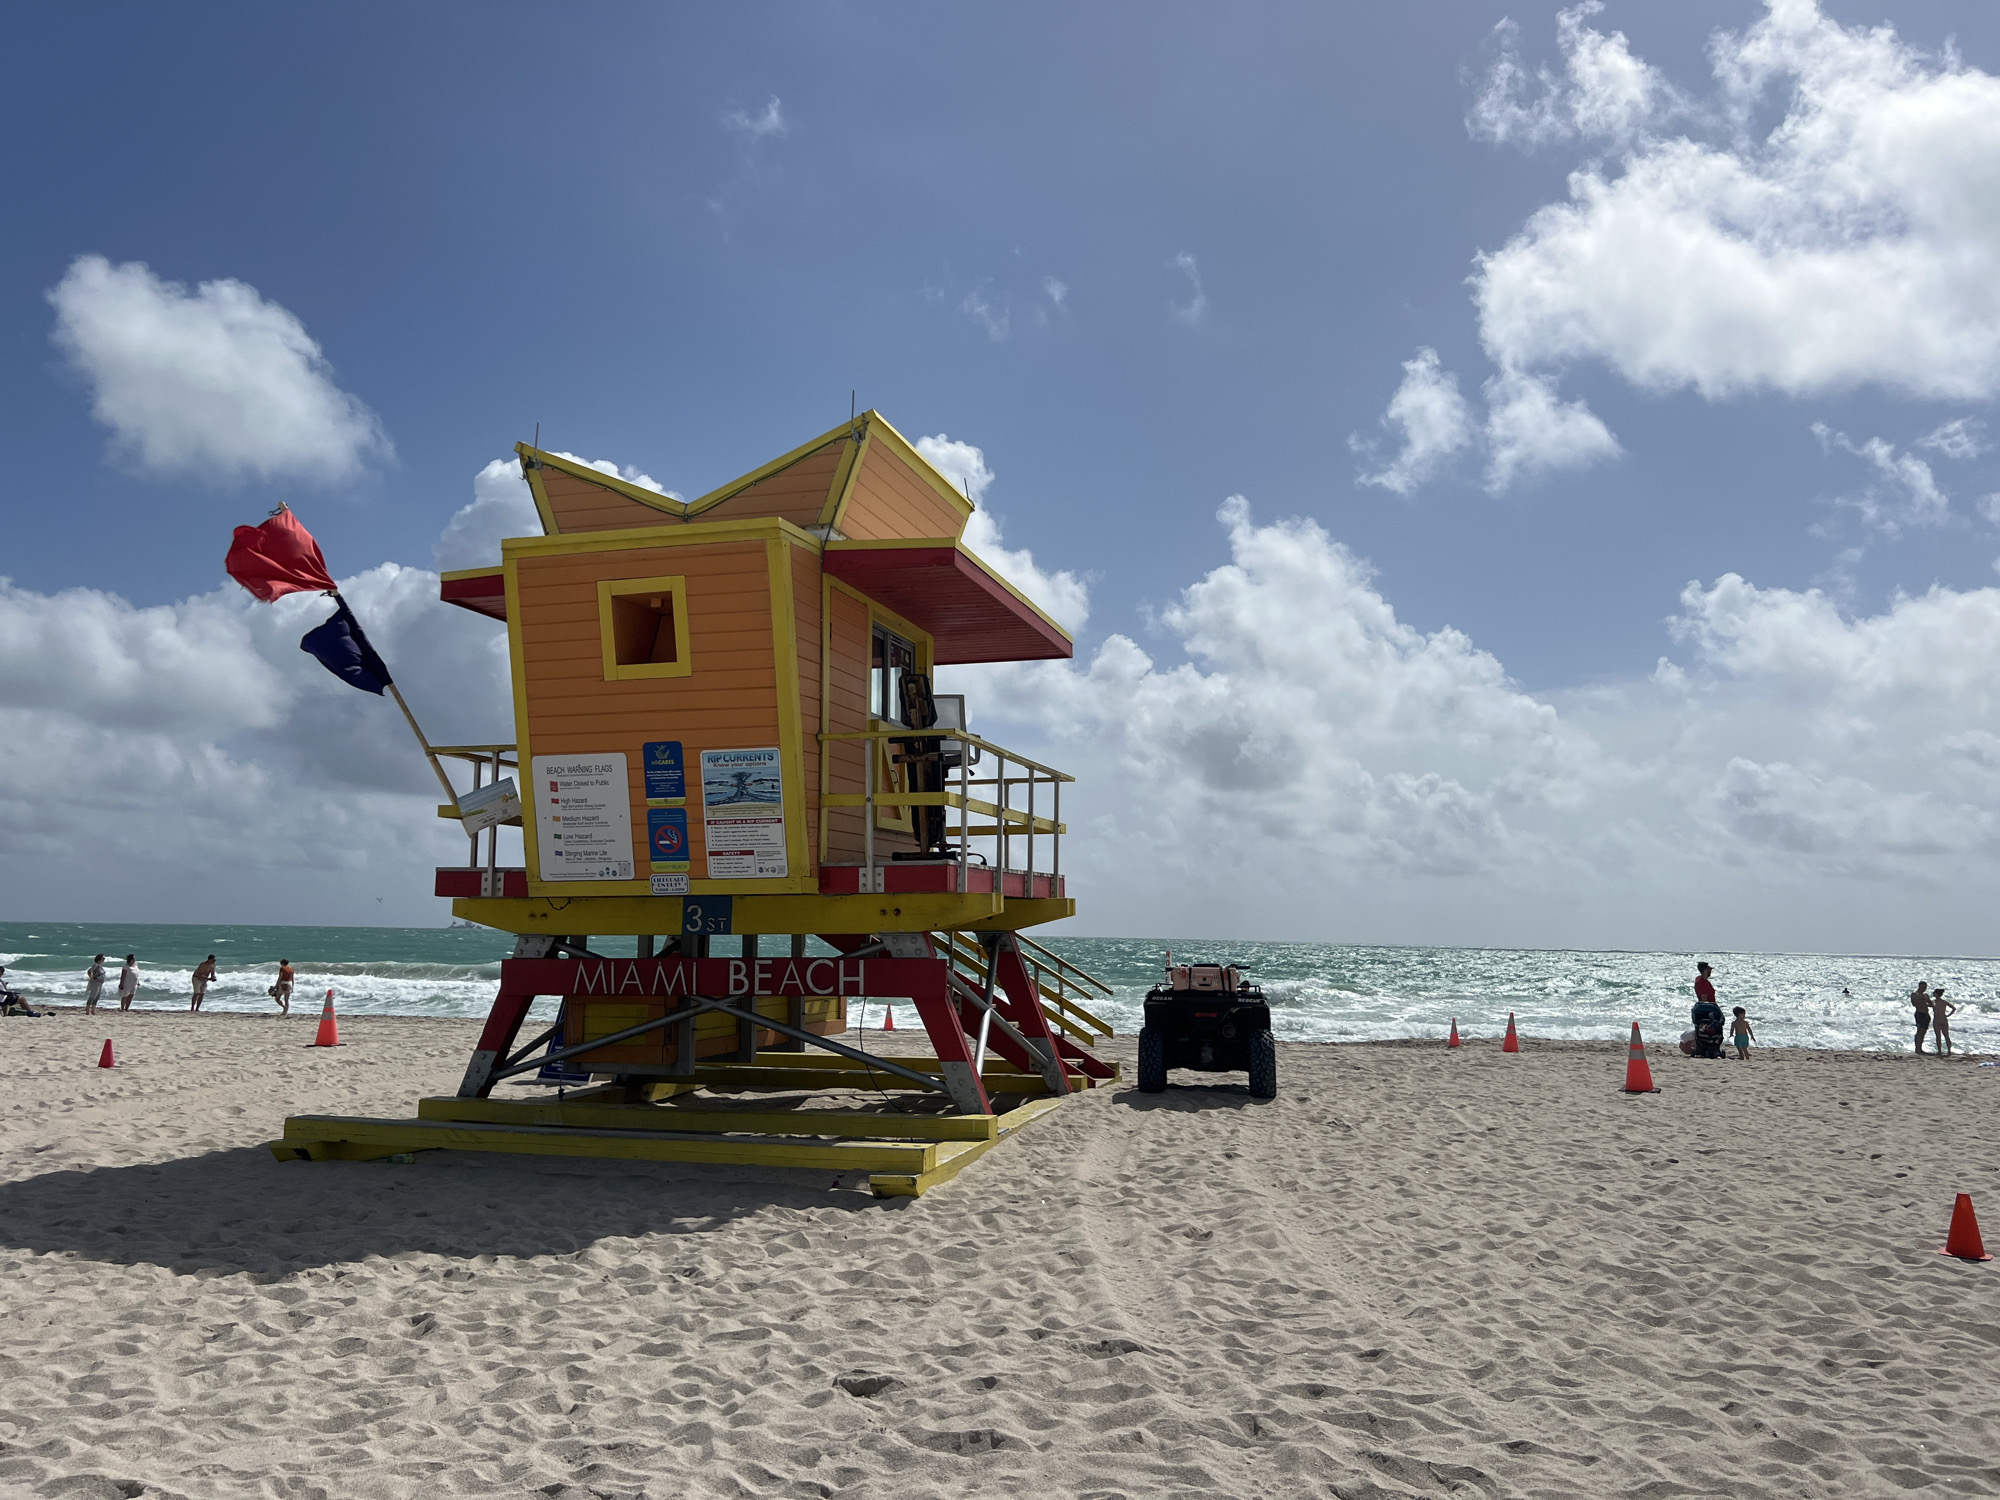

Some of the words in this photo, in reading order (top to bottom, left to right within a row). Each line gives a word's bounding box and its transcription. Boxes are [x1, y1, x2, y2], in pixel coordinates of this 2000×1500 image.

[707, 754, 722, 763] RIP
[723, 752, 774, 763] CURRENTS
[546, 766, 565, 775] BEACH
[567, 765, 593, 774] WARNING
[594, 764, 613, 773] FLAGS
[564, 850, 583, 858] Stinging
[583, 849, 599, 857] Marine
[686, 904, 703, 932] 3
[706, 917, 727, 932] ST
[573, 960, 697, 995] MIAMI
[729, 959, 865, 995] BEACH
